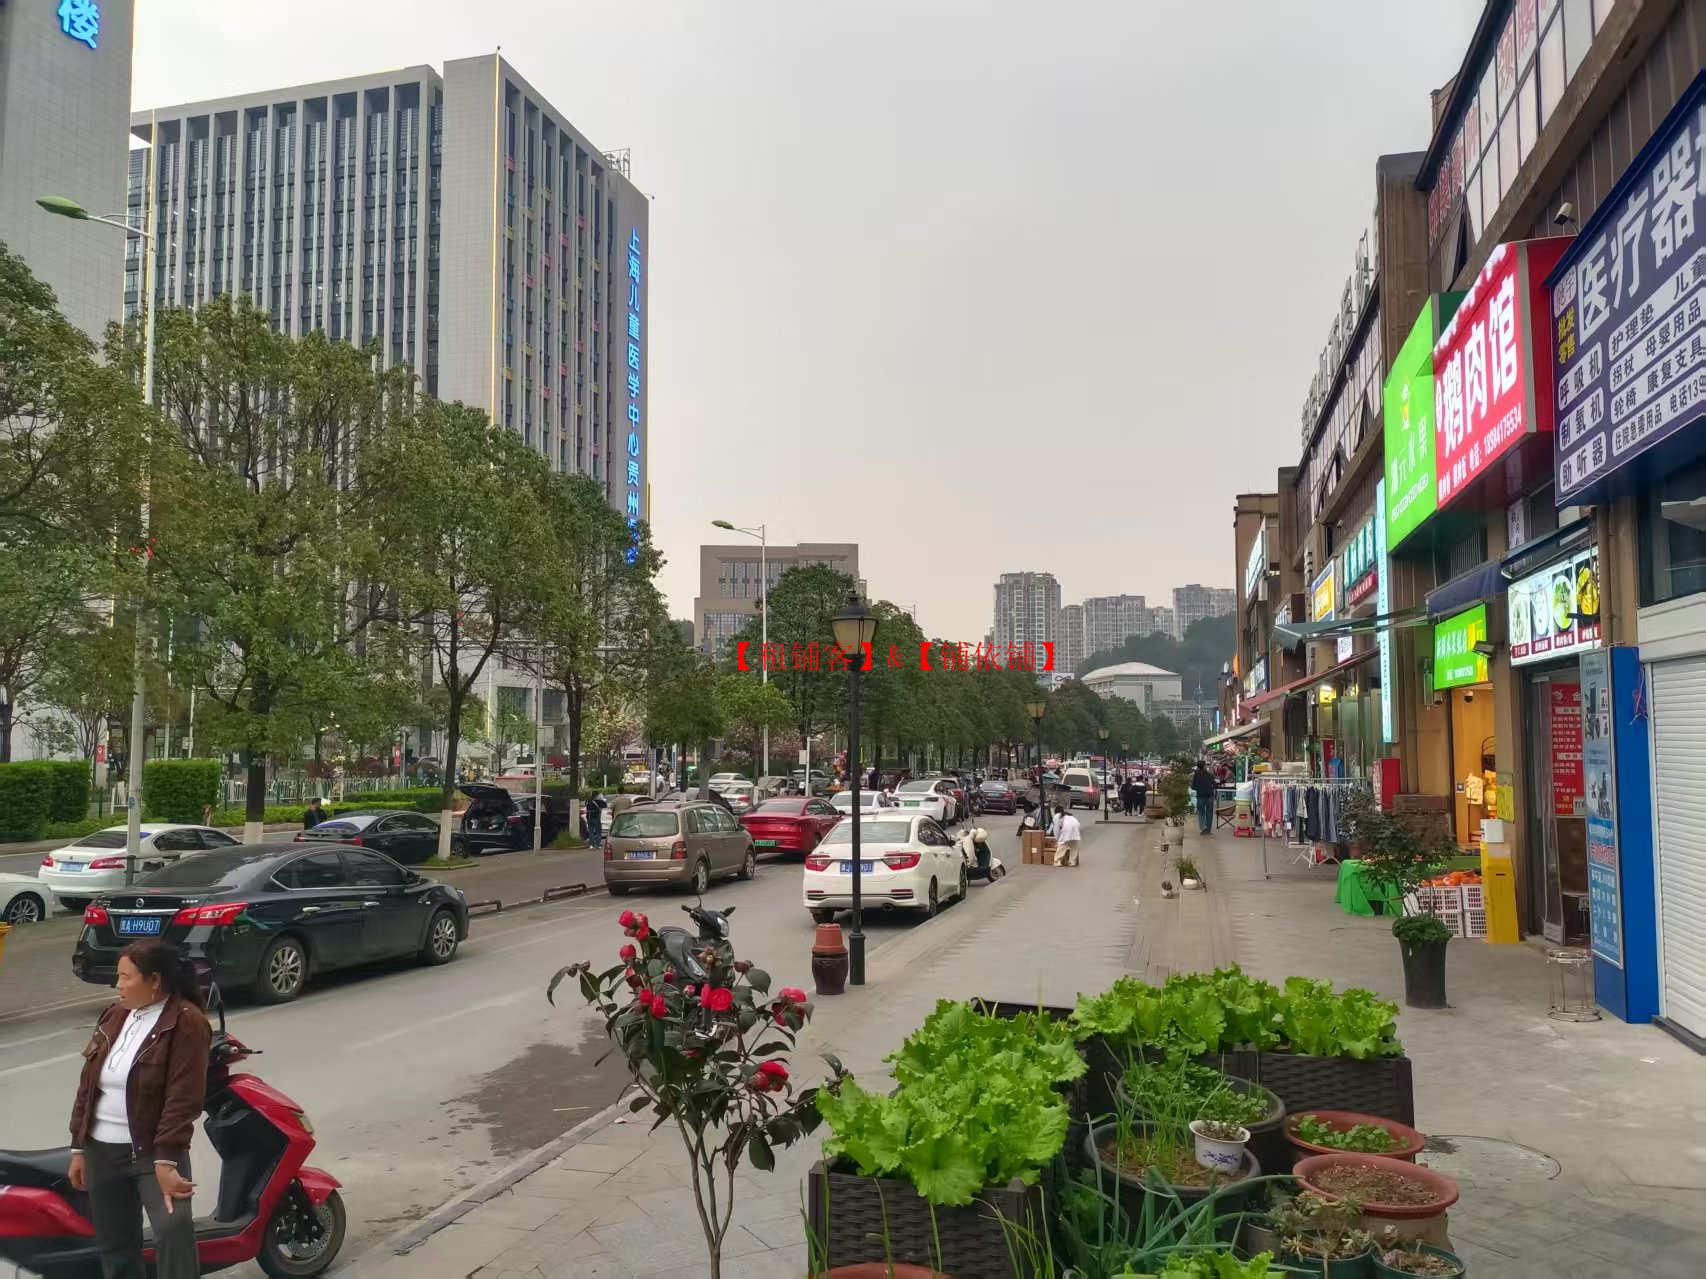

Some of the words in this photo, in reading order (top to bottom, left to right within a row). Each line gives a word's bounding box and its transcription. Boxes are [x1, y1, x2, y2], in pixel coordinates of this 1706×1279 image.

[1578, 105, 1706, 345] 医疗器
[1612, 303, 1654, 352] 护理垫
[1613, 354, 1634, 388] 拐杖
[1645, 298, 1701, 357] 母婴用品
[1560, 351, 1600, 405] 呼吸机
[1614, 387, 1636, 419] 轮椅
[1647, 336, 1702, 394] 康复支具
[1561, 399, 1602, 444] 制氧机
[1615, 403, 1662, 451] 住院急需用品
[1563, 437, 1603, 487] 助听器
